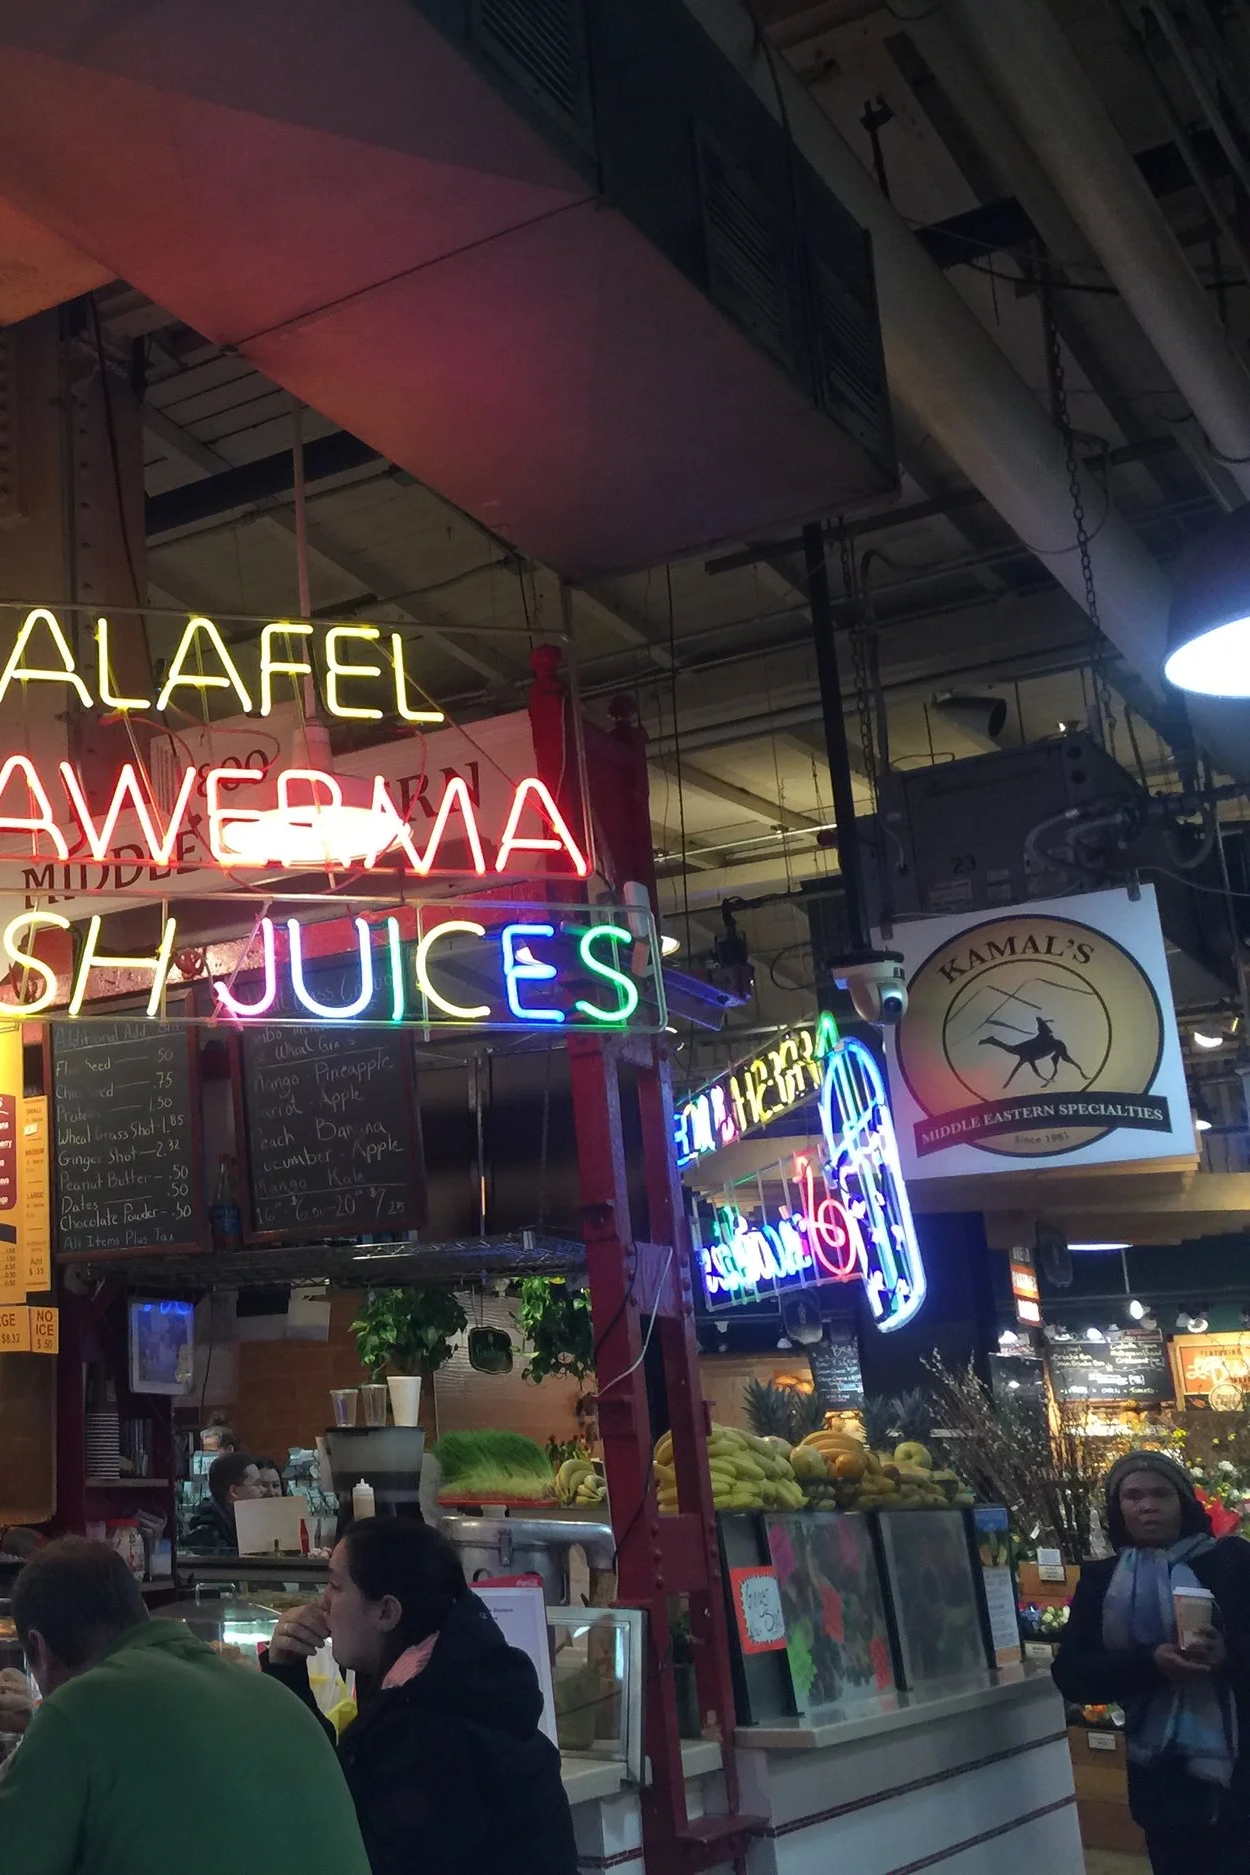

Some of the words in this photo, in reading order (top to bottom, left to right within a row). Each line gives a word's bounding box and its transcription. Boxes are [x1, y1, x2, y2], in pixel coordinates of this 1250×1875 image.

[213, 917, 639, 1022] JUICES
[936, 934, 1097, 986] KAMAL'S
[921, 1116, 982, 1146] MIDDLE
[983, 1104, 1055, 1125] EASTERN
[1058, 1102, 1164, 1122] SPECIALTIES
[328, 1165, 367, 1187] Kale
[61, 1193, 99, 1214] Dates
[60, 1207, 119, 1232] Chocolate
[123, 1202, 159, 1225] Powder
[63, 1236, 83, 1250] All
[85, 1234, 121, 1248] Items
[125, 1228, 149, 1246] Plus
[154, 1226, 176, 1242] Tax
[36, 1309, 54, 1322] NO
[35, 1323, 55, 1337] ICE
